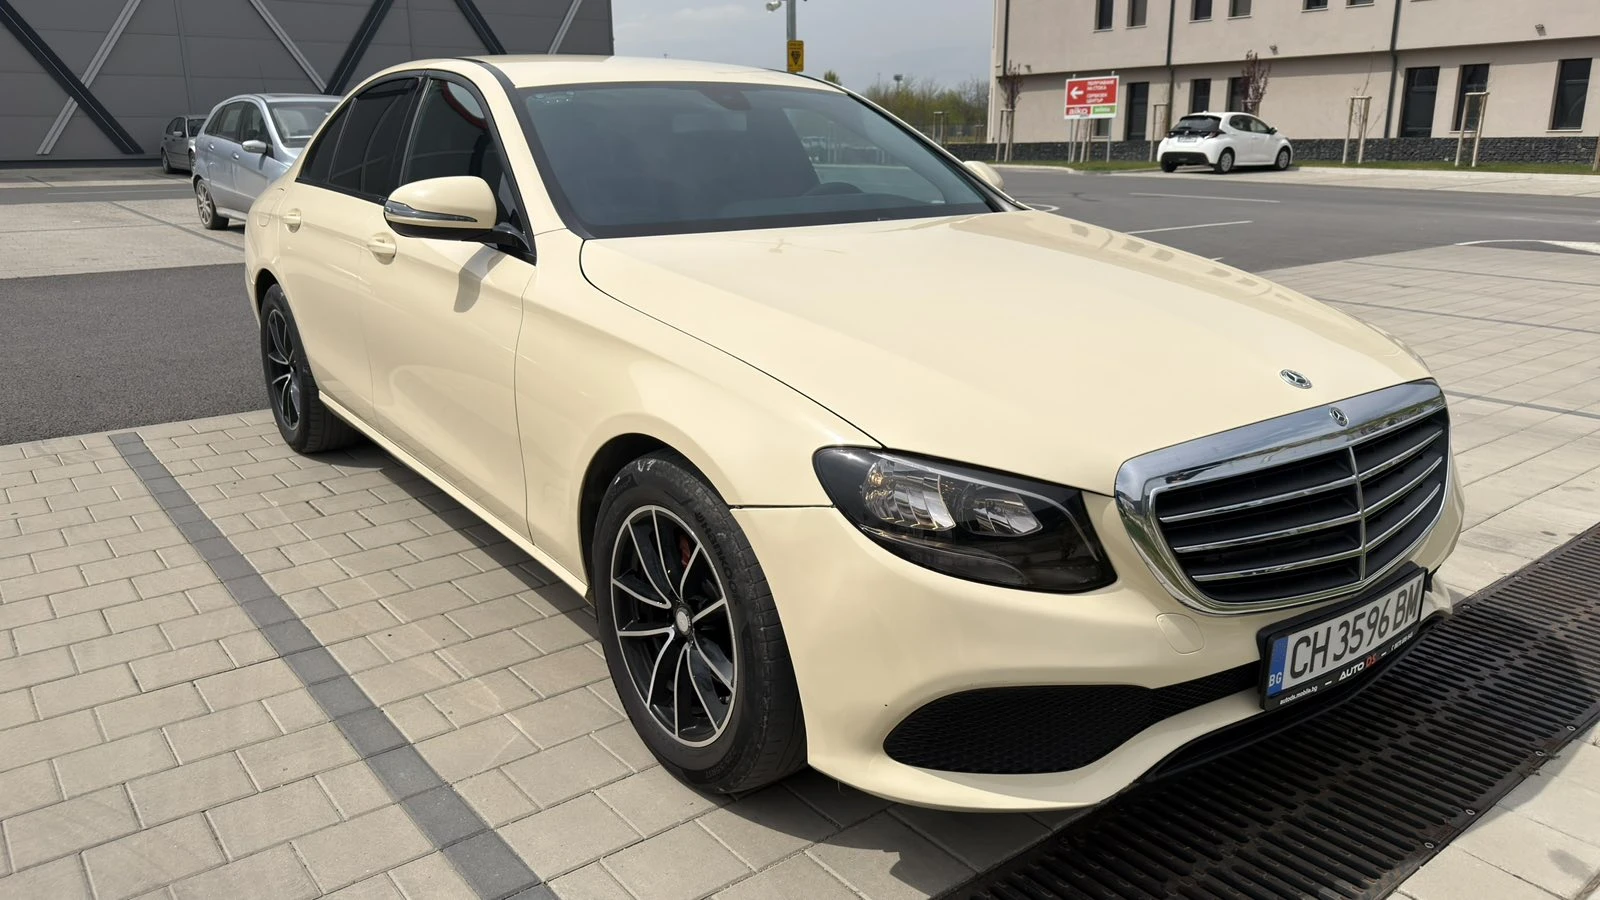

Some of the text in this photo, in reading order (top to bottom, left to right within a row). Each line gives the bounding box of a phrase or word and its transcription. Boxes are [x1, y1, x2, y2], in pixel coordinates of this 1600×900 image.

[1290, 580, 1421, 679] CH 3596 BM
[1268, 672, 1283, 687] BG
[1338, 662, 1364, 682] AUTO
